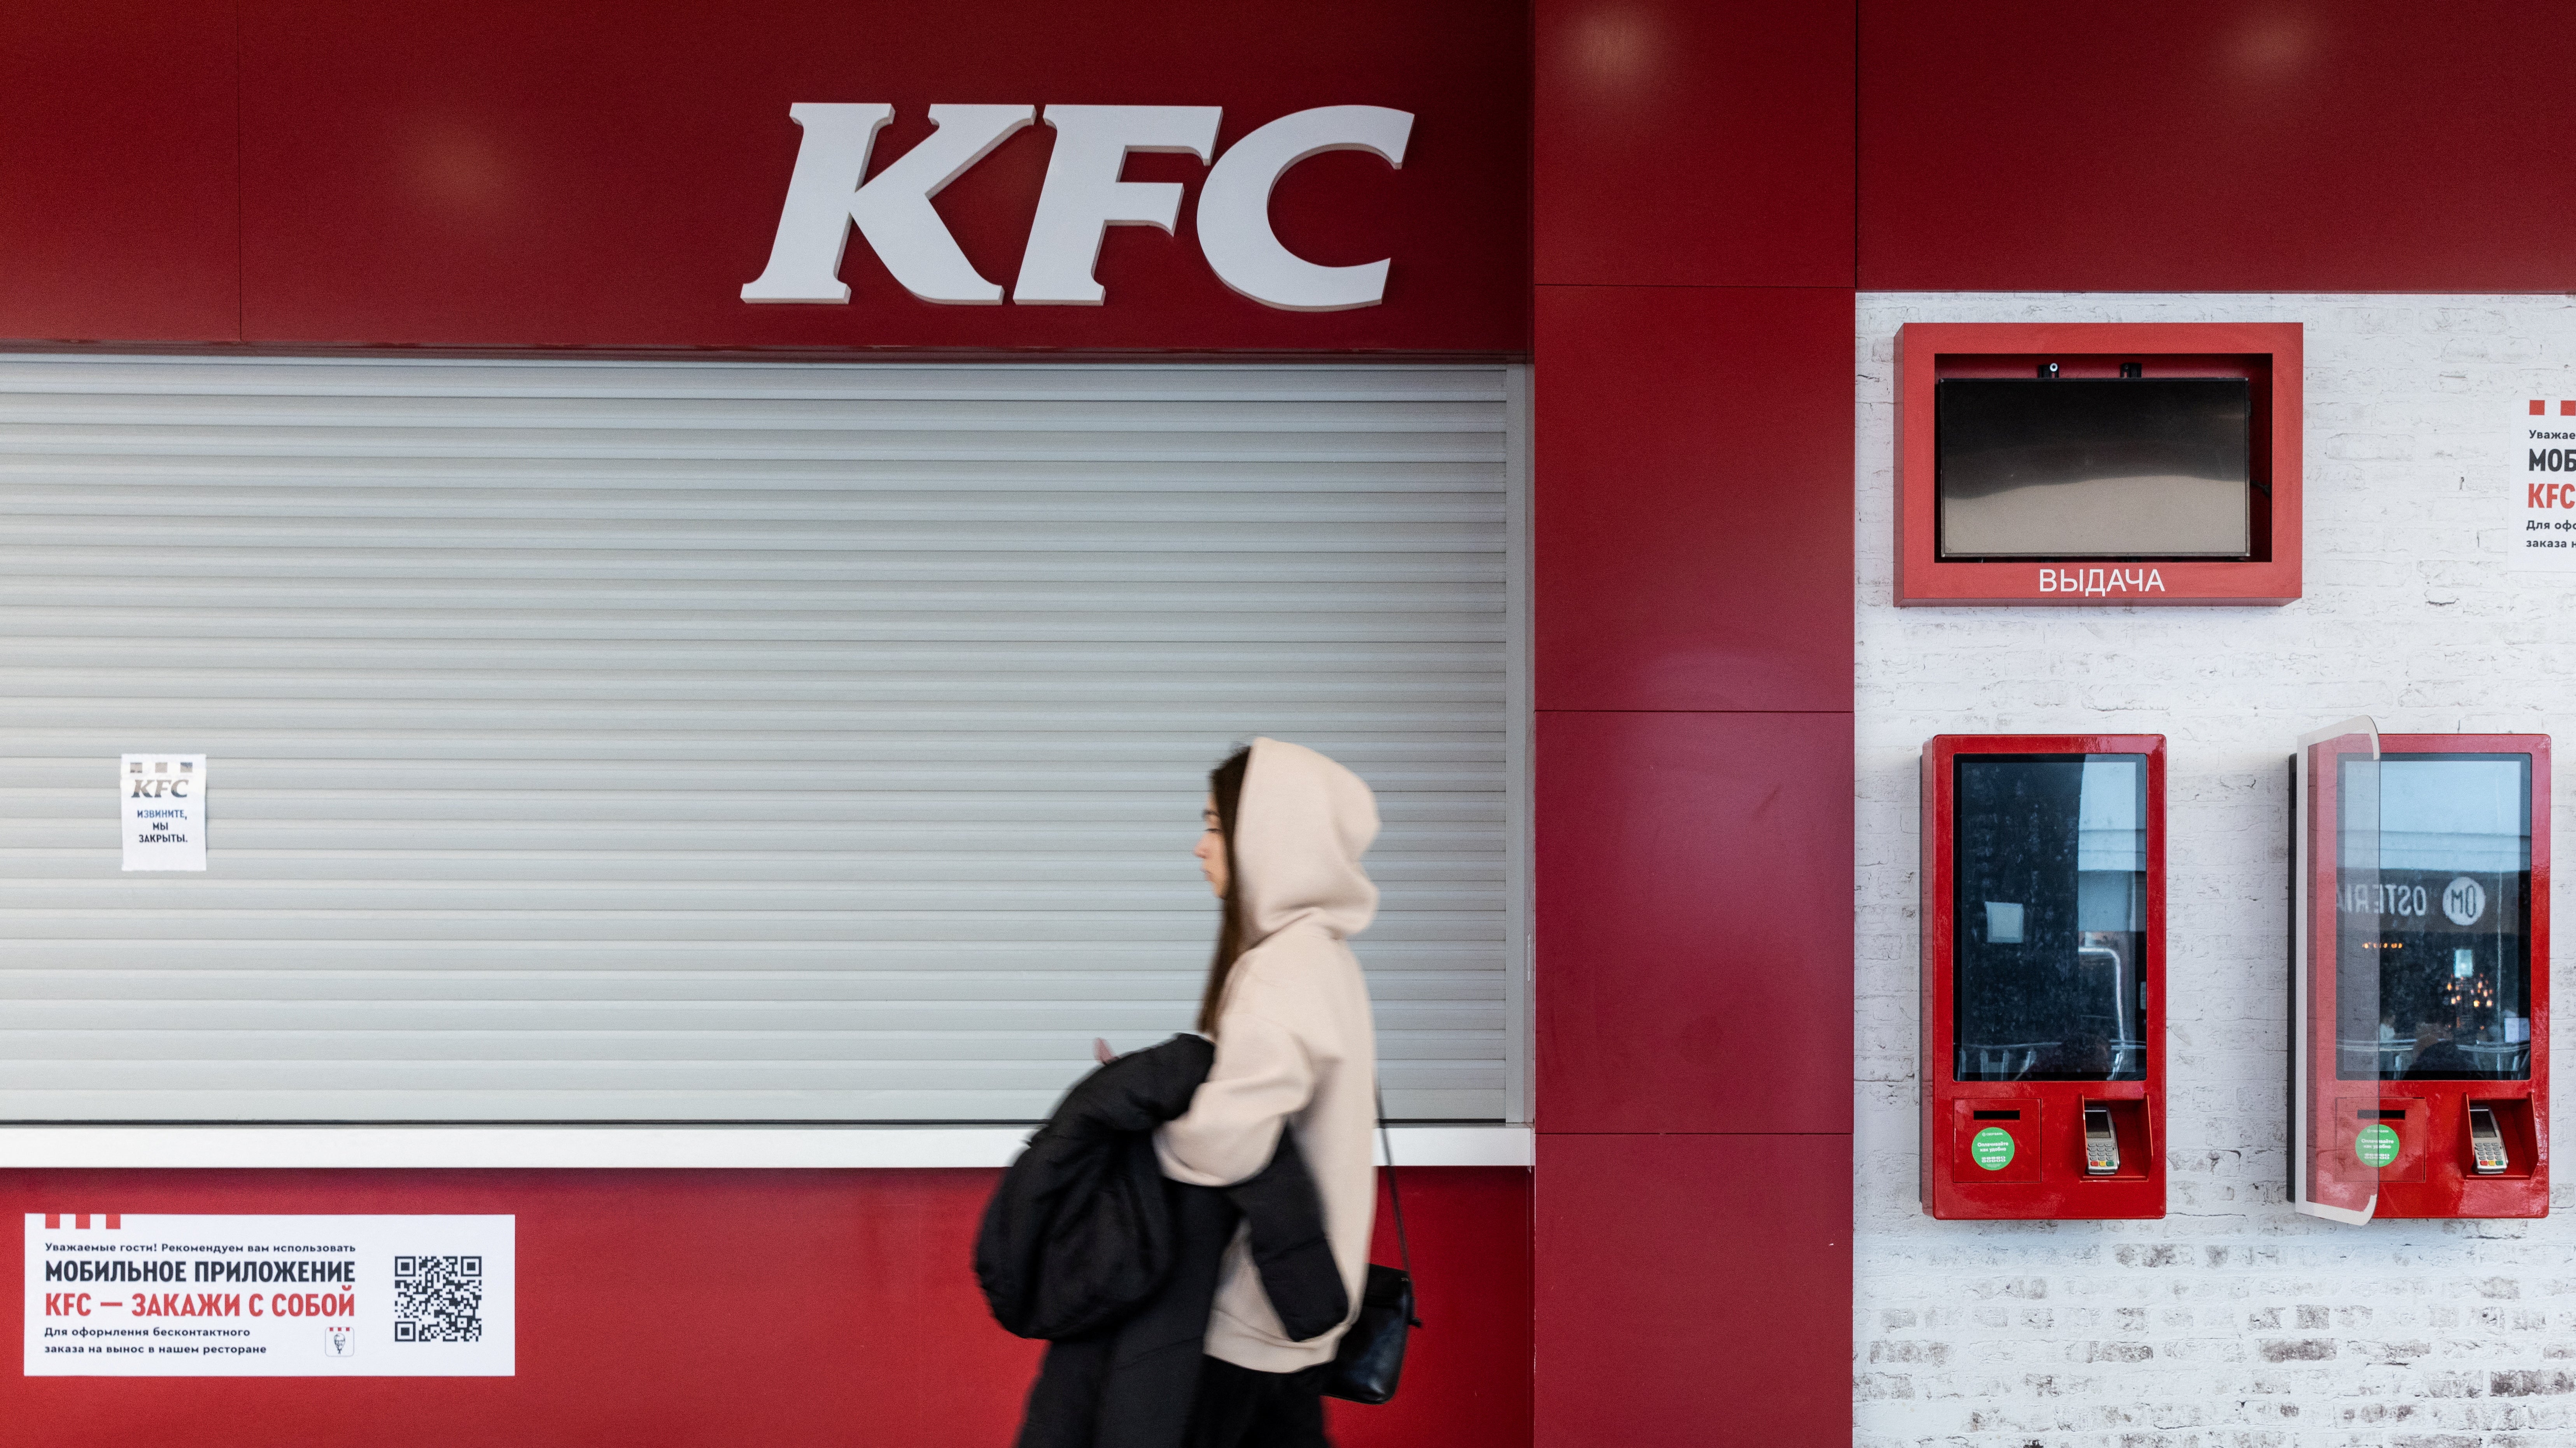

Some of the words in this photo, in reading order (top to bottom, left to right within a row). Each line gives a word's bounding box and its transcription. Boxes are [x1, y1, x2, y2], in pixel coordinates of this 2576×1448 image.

[740, 102, 1415, 312] KFC
[2529, 449, 2576, 472] МОБ
[2528, 484, 2576, 509] KFC
[2526, 521, 2550, 531] Для
[2039, 569, 2165, 597] ВЫДАЧА
[131, 779, 189, 798] KFC
[137, 810, 187, 820] ИЗВИНИТЕ,
[152, 822, 169, 831] МЫ
[139, 834, 188, 843] ЗАКРЫТЫ.
[46, 1243, 116, 1252] Уважаемые
[120, 1243, 157, 1252] гости!
[161, 1244, 244, 1255] Рекомендуем
[46, 1260, 187, 1283] МОБИЛЬНОЕ
[195, 1261, 356, 1283] ПРИЛОЖЕНИЕ
[46, 1293, 92, 1317] KFC
[131, 1293, 241, 1317] ЗАКАЖИ
[249, 1294, 264, 1317] С
[271, 1285, 355, 1317] СОБОЙ
[45, 1327, 68, 1338] Для
[72, 1327, 149, 1338] оформления
[153, 1327, 250, 1337] бесконтактного
[203, 1347, 267, 1356] ресторане
